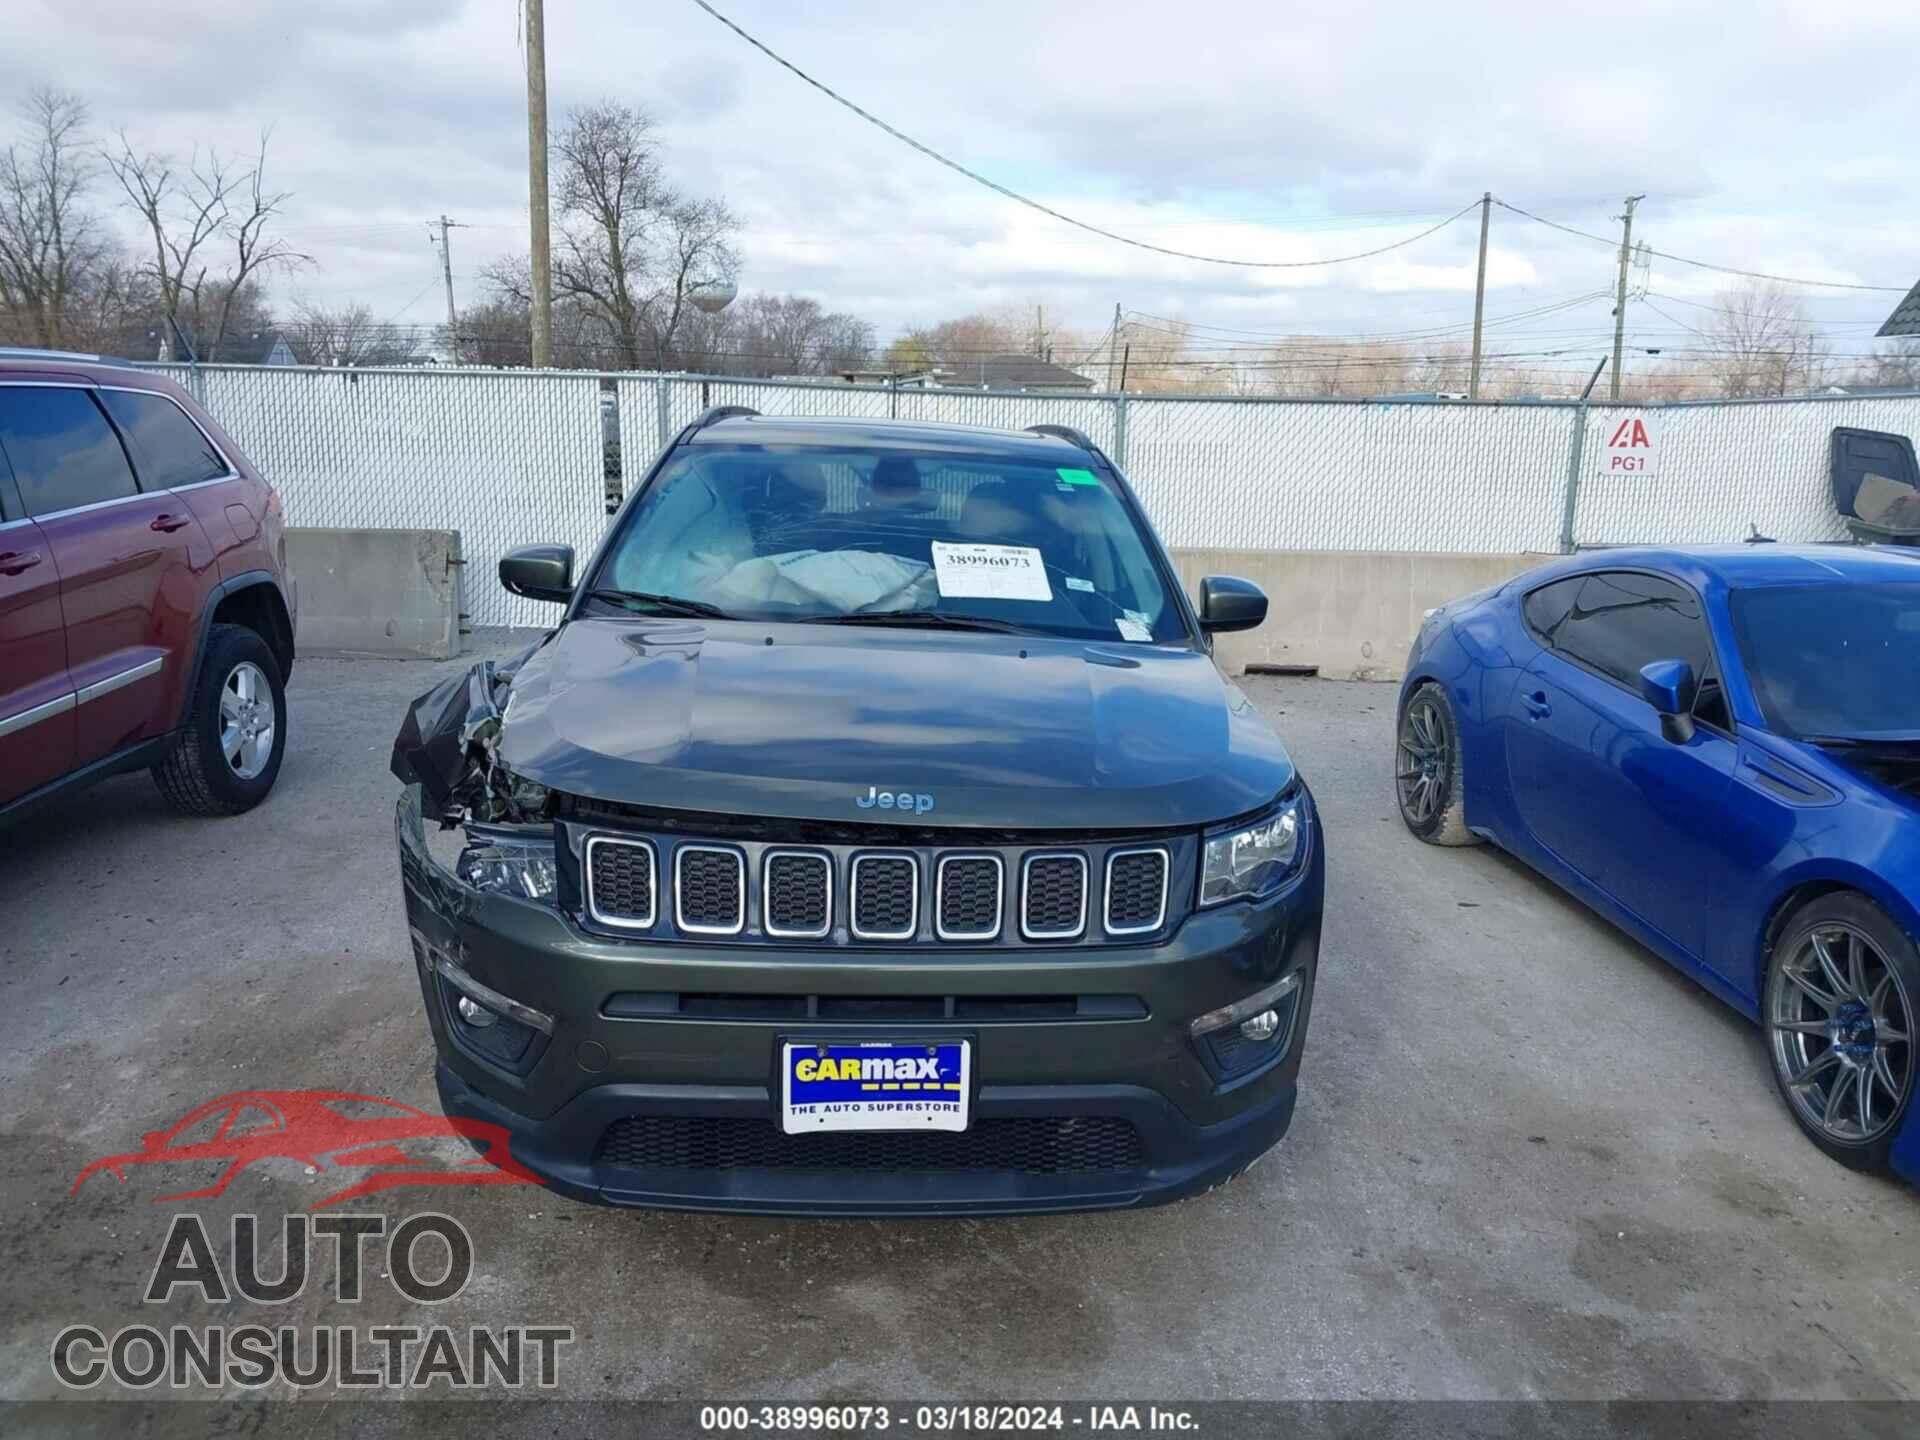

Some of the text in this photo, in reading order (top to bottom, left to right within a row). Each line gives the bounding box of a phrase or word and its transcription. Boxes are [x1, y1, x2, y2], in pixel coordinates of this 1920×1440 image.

[1611, 456, 1645, 471] PG1
[946, 554, 1031, 569] 38996073
[856, 786, 934, 816] Jeep
[790, 1103, 960, 1115] THE AUTO SUPERSTORE
